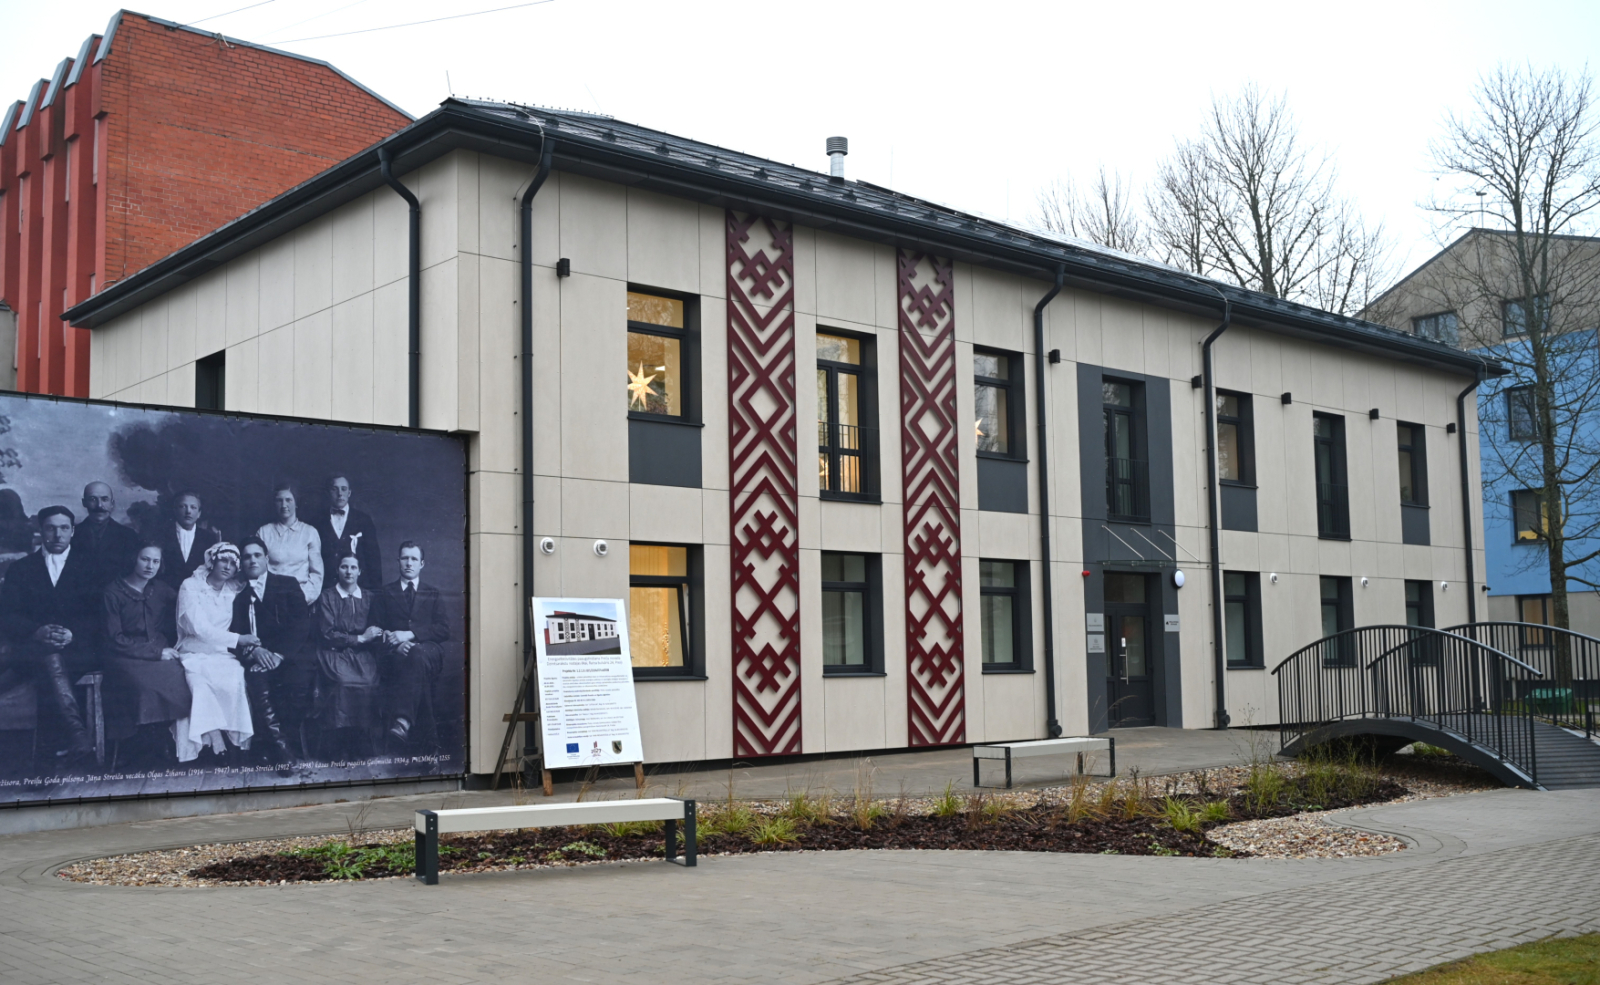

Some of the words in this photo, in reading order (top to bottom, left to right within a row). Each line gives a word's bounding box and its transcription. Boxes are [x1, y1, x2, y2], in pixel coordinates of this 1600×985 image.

[44, 775, 60, 786] Goda
[147, 769, 163, 780] Olgas
[188, 767, 203, 777] (1914
[214, 766, 230, 775] 1947)
